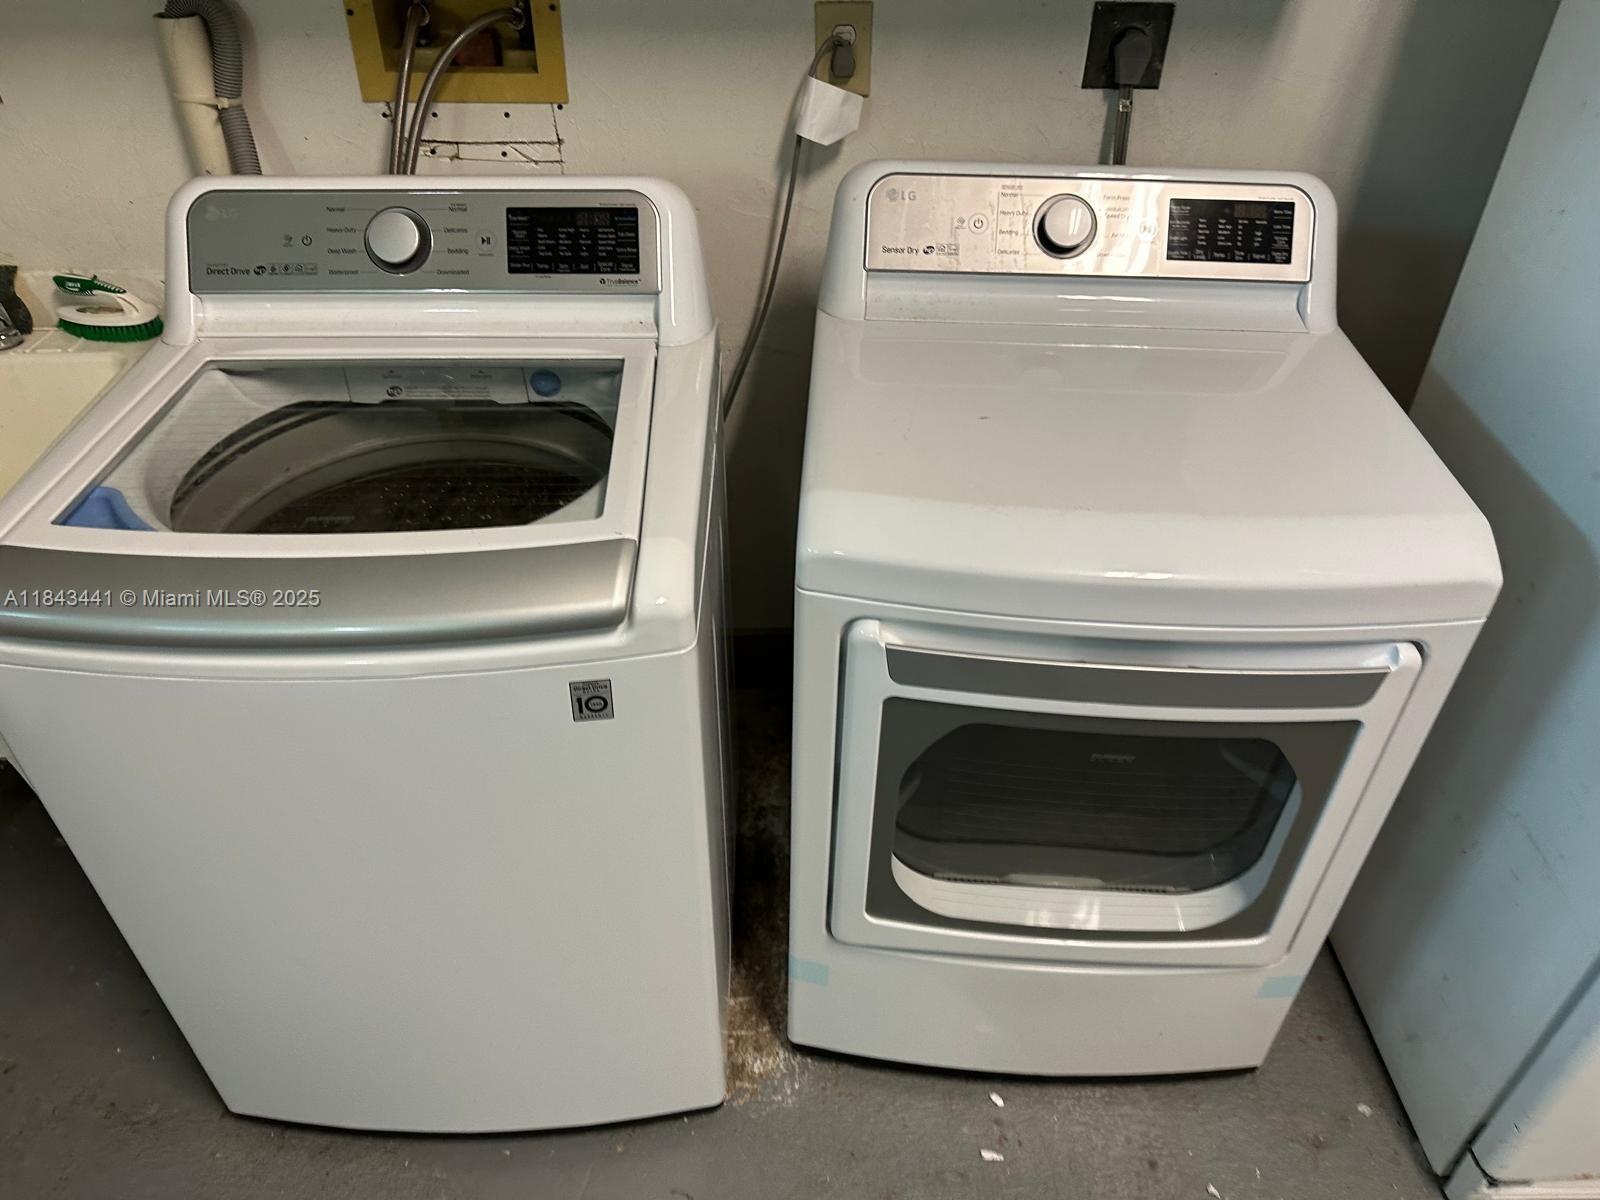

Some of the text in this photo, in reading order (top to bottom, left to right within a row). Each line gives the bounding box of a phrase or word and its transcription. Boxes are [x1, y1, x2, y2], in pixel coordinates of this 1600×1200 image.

[901, 190, 917, 201] LG
[881, 245, 905, 254] Sensor
[907, 246, 920, 256] Dry
[206, 267, 229, 276] Direct
[230, 267, 251, 276] Drive
